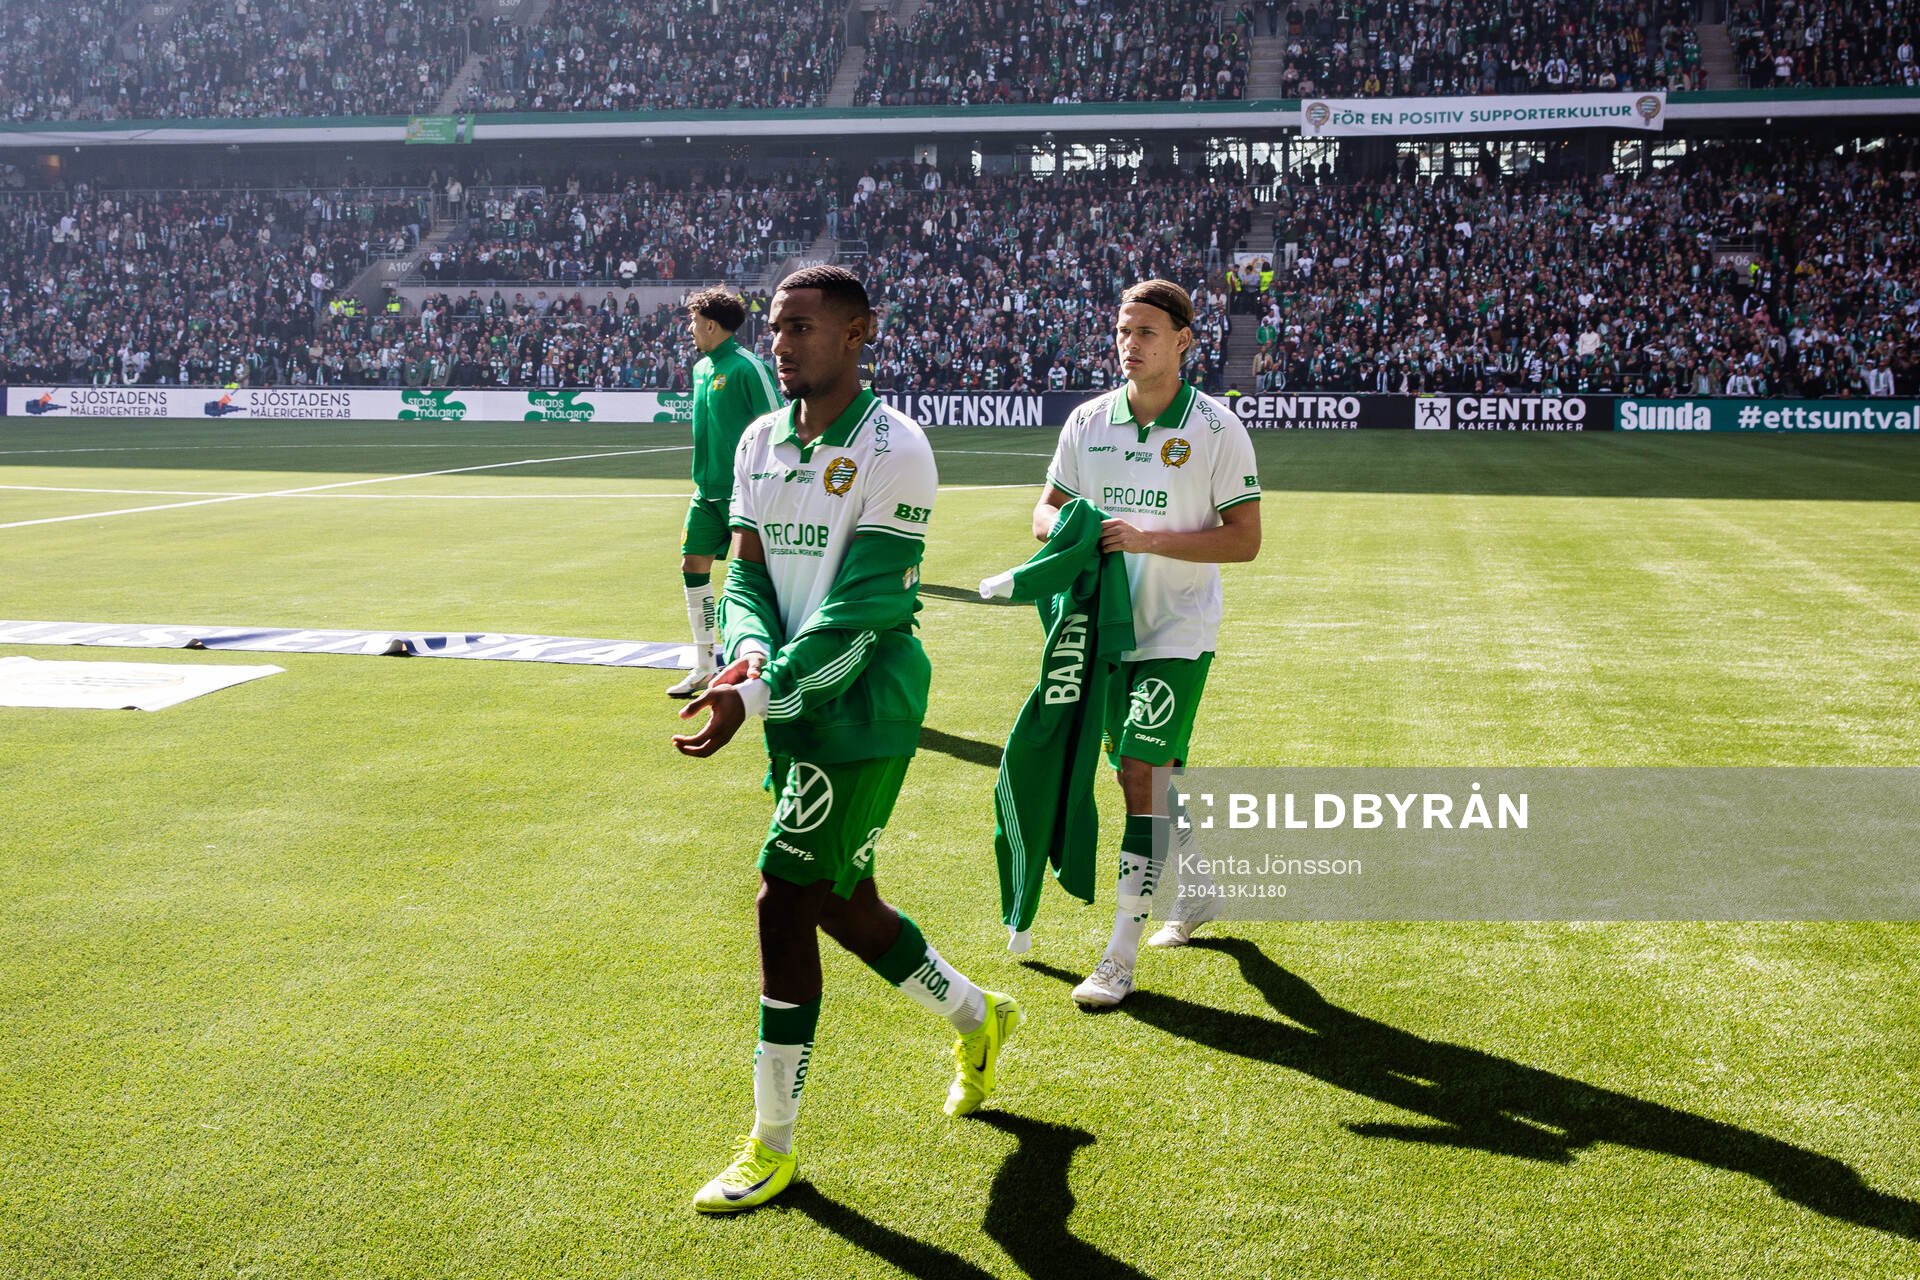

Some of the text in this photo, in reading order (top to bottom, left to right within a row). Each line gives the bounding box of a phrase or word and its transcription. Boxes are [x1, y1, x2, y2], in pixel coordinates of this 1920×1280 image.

[1333, 105, 1632, 126] FÖR EN POSITIV SUPPORTERKULTUR
[70, 387, 168, 405] SJÖSTADENS
[250, 389, 351, 407] SJÖSTADENS
[70, 404, 168, 416] MÅLERICENTER AB
[250, 406, 351, 418] MÅLERICENTER AB
[1235, 396, 1361, 420] CENTRO
[1456, 398, 1587, 421] CENTRO
[1620, 401, 1711, 431] Sunda
[1284, 420, 1293, 429] &
[1299, 421, 1358, 430] KLINKER
[1738, 405, 1920, 430] #ettsuntval
[1458, 422, 1584, 432] KAKEL & KLINKER
[1103, 487, 1168, 508] PROJOB
[1045, 613, 1088, 704] BAJEN
[1135, 733, 1161, 744] CRAFT
[775, 840, 807, 858] CRAFT
